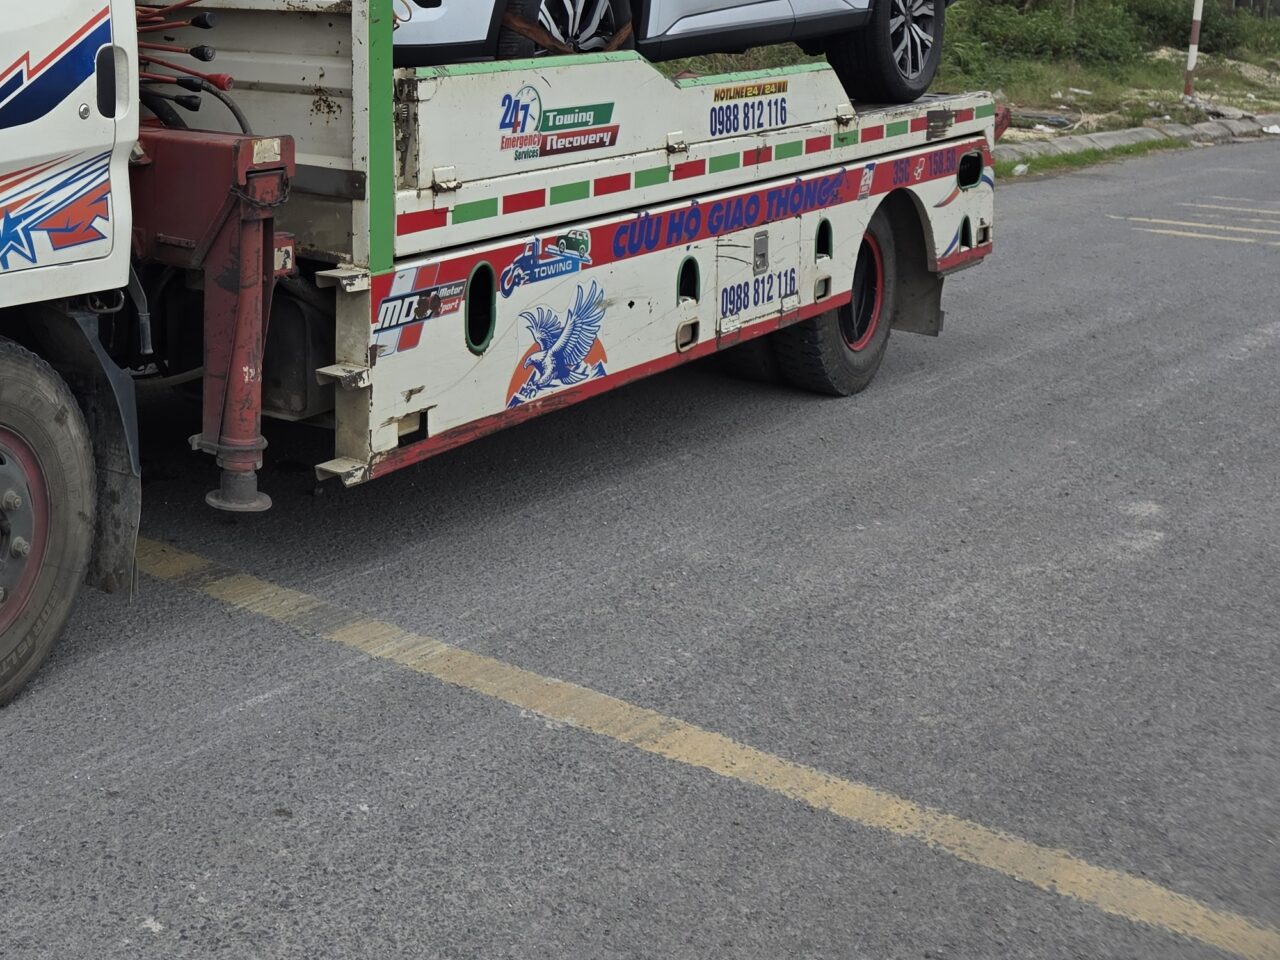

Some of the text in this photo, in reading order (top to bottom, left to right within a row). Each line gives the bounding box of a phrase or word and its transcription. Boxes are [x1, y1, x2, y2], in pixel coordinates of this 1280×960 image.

[713, 86, 745, 102] HOTLINE
[545, 109, 594, 126] Towing
[710, 97, 787, 137] 0988 812 116
[500, 133, 543, 151] Emergency
[545, 131, 612, 151] Recovery
[514, 147, 539, 160] Services
[612, 209, 663, 258] CỨU
[665, 199, 703, 252] HỘ
[706, 194, 761, 235] GIAO
[534, 260, 573, 278] TOWING
[439, 286, 464, 298] Motor
[721, 267, 796, 319] 0988 812 116
